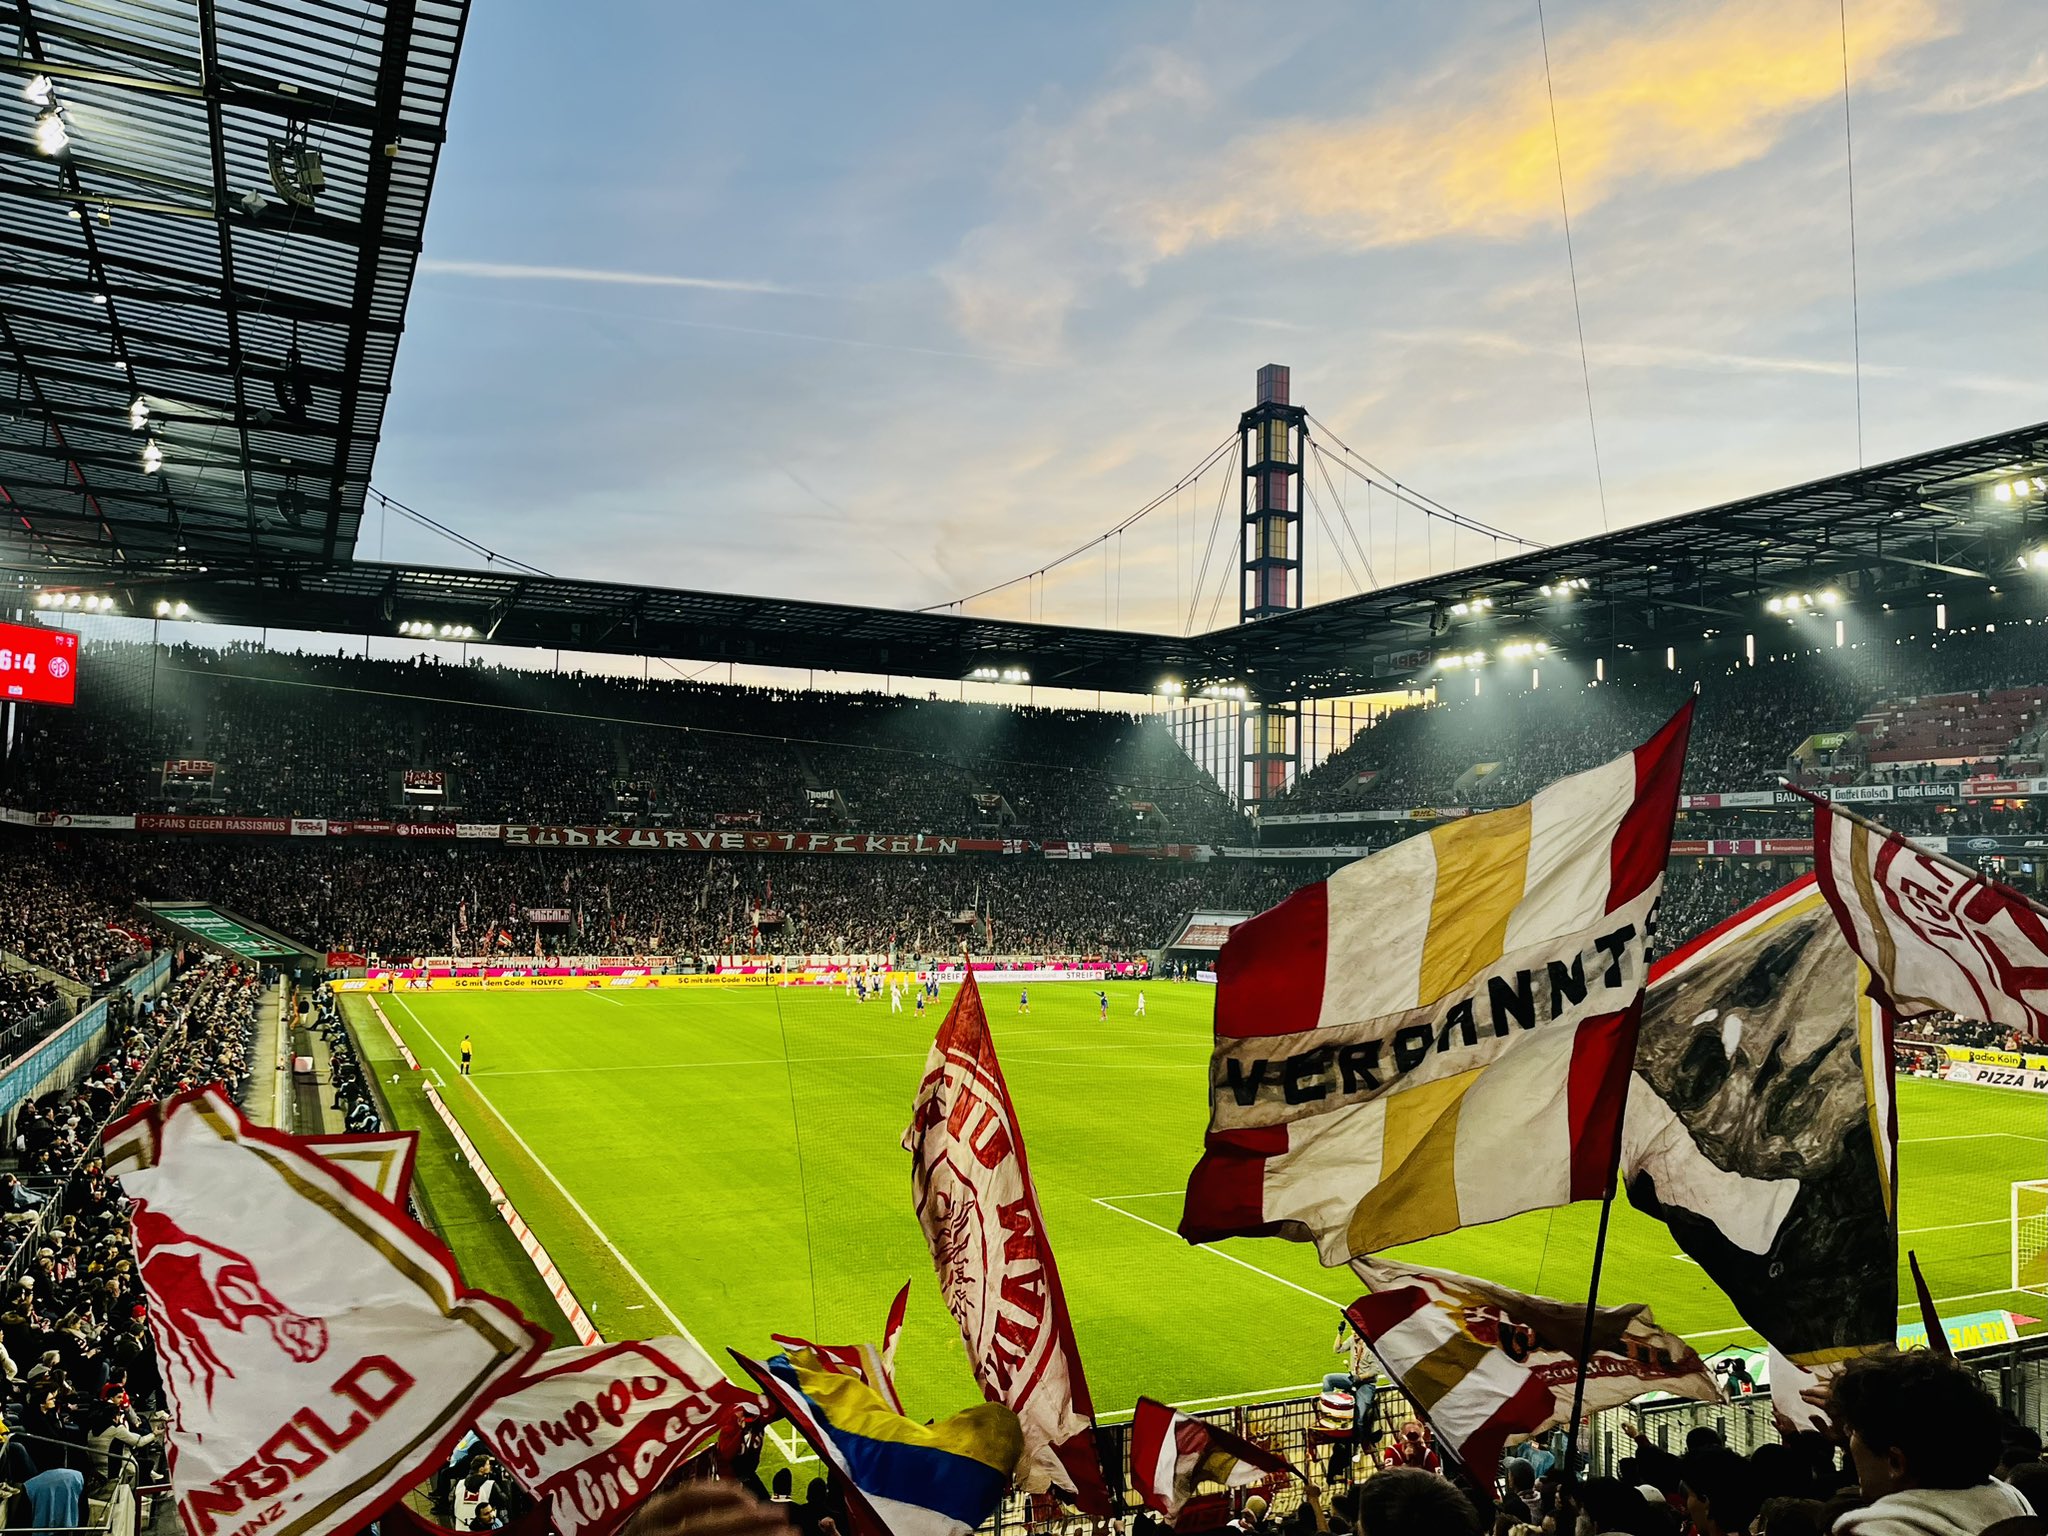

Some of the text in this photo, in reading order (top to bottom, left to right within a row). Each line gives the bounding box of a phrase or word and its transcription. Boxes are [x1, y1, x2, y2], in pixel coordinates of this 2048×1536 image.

[404, 769, 442, 782] HAWKS
[141, 817, 186, 829] FC-FANS
[188, 818, 223, 830] GEGEN
[225, 819, 286, 831] RASSISMUS
[410, 824, 456, 836] Holweide
[505, 826, 745, 849] SÜDKURVE
[864, 834, 958, 854] KÖLN
[1969, 1051, 2019, 1065] Radio Köln
[1976, 1069, 2026, 1087] PIZZA
[494, 1375, 668, 1480] Gruppo
